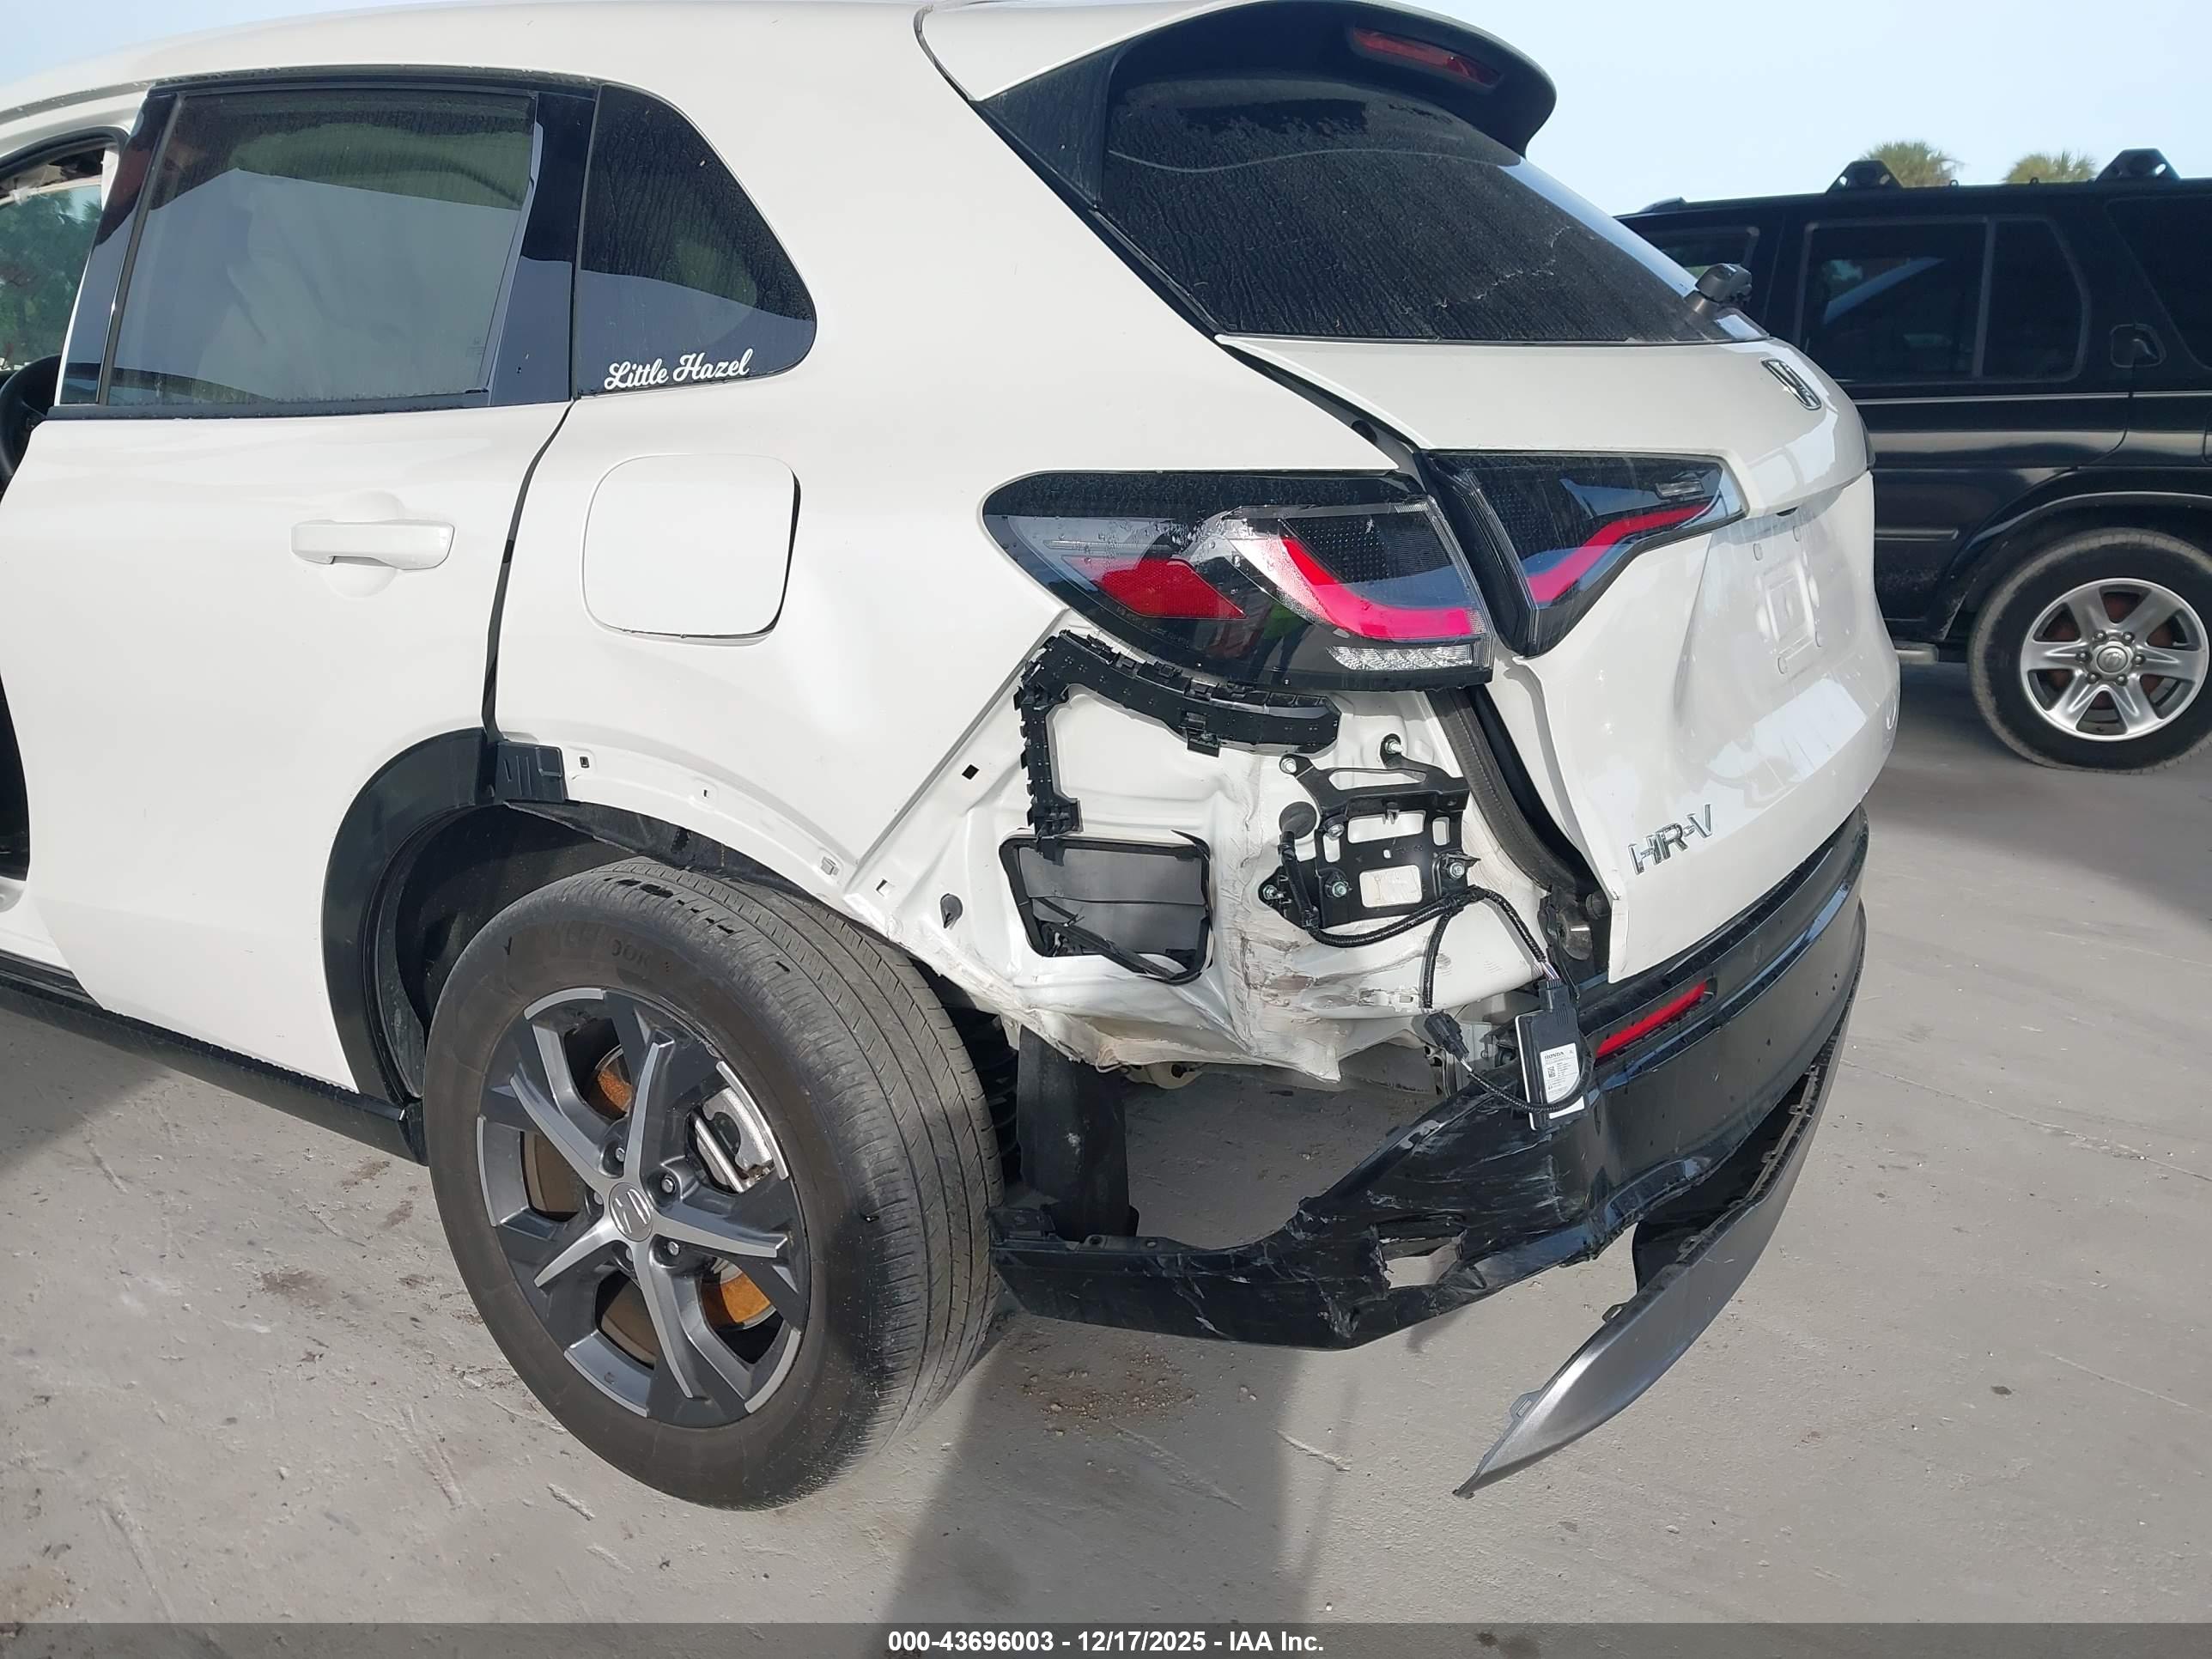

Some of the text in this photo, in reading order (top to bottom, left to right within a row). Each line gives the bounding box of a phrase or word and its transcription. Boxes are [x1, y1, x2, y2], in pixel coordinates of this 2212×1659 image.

[604, 348, 754, 390] Little Hazel
[1627, 804, 1712, 875] HR-V
